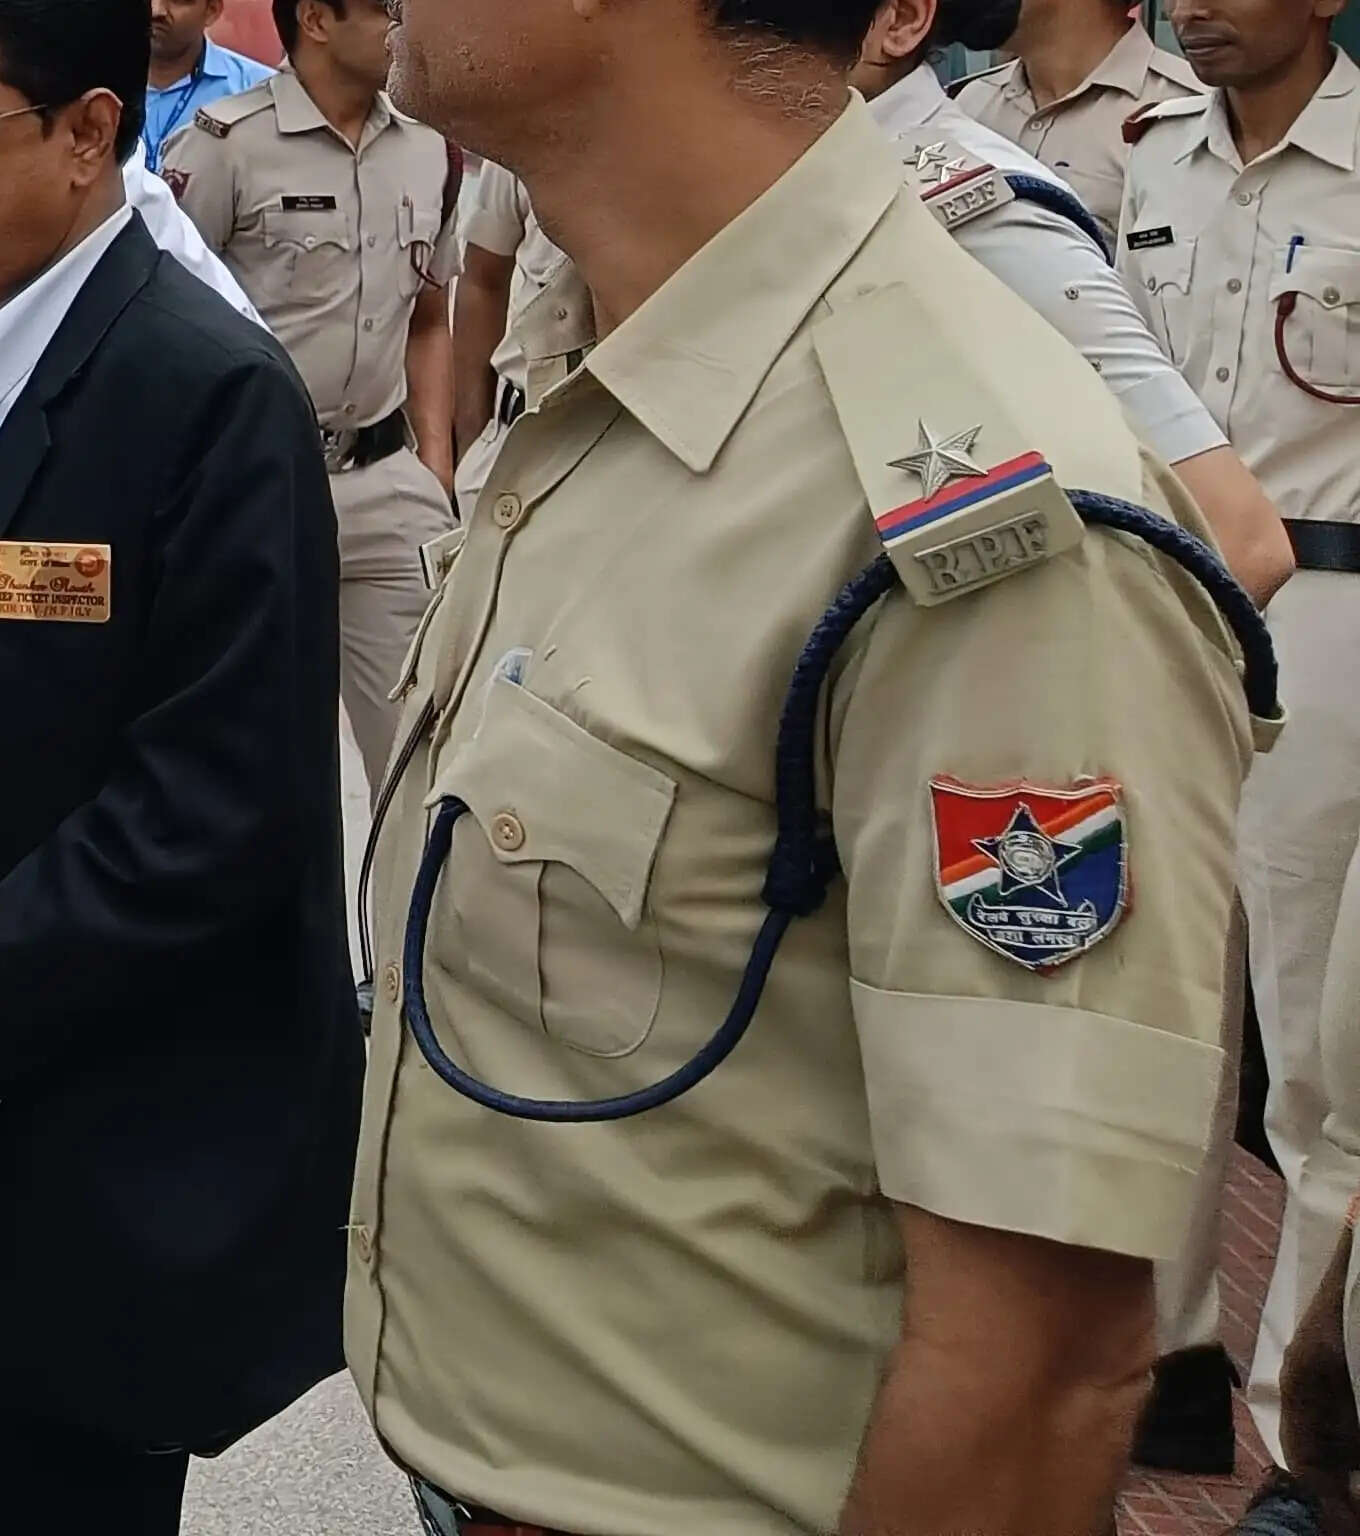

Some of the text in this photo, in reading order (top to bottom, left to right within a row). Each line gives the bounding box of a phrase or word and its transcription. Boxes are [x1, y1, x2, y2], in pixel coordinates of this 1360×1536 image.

[924, 518, 1048, 594] RPF
[16, 592, 49, 604] TICKET
[51, 594, 105, 606] INSPECTOR
